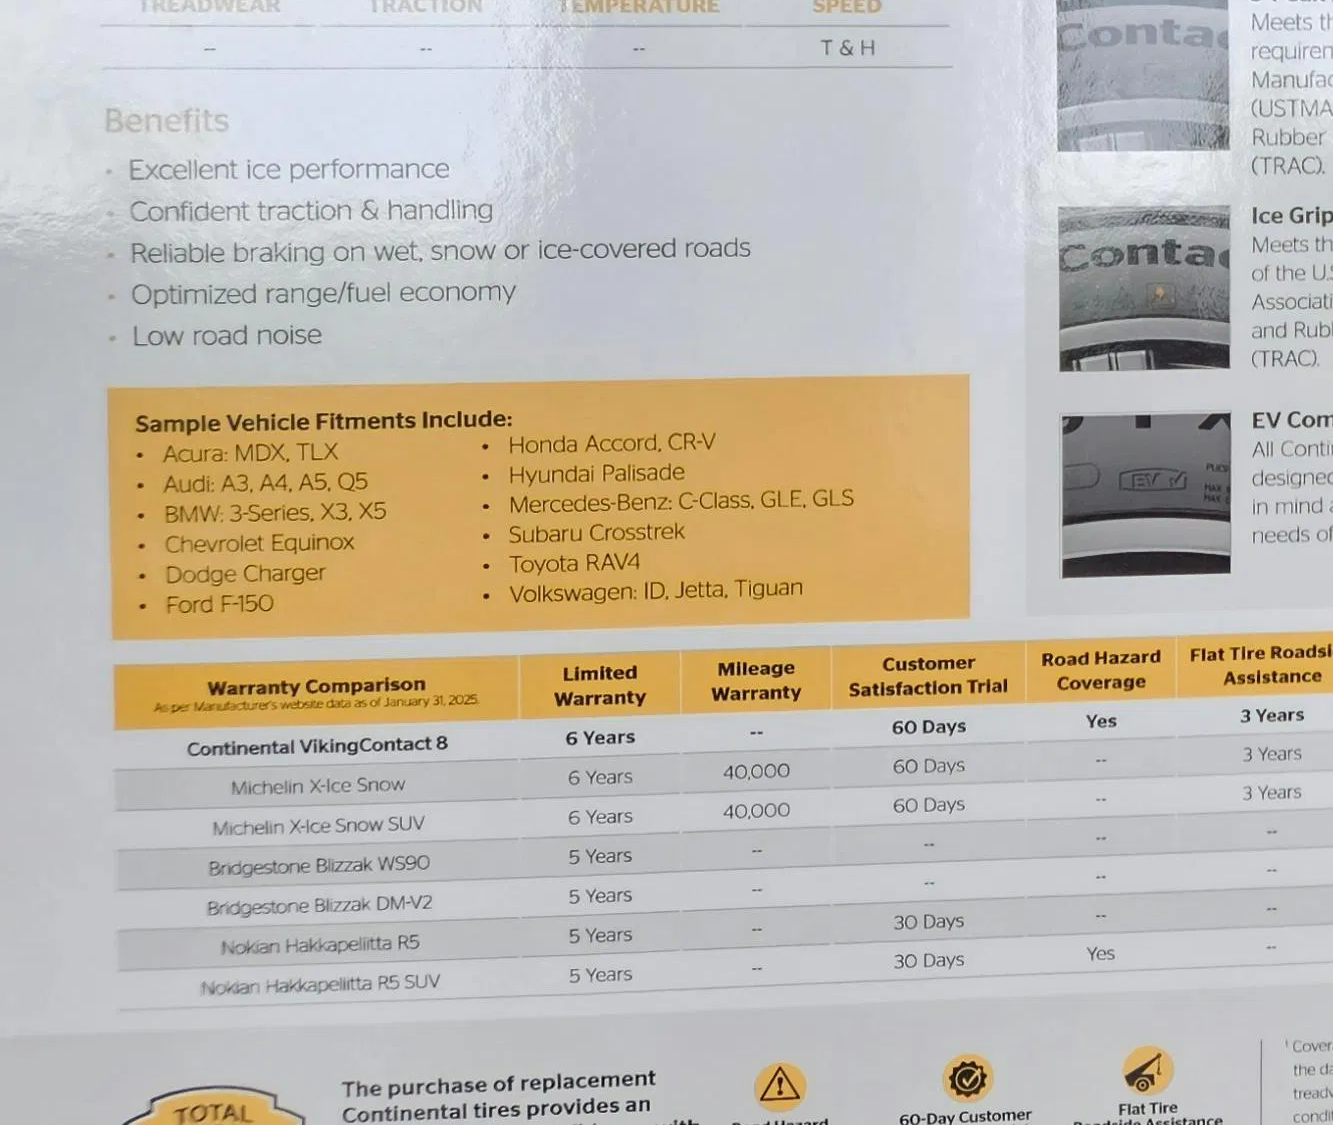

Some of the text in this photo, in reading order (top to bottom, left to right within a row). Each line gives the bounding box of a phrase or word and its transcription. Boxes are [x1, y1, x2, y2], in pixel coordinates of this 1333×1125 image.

[820, 38, 876, 57] T & H
[104, 107, 230, 136] Benefits
[129, 157, 450, 185] Excellent ice performance
[130, 197, 493, 224] Confident traction & handling
[1252, 206, 1284, 225] Ice
[131, 236, 752, 267] Reliable braking on wet, snow or ice-covered roads
[131, 280, 517, 308] Optimized range/fuel economy
[133, 323, 323, 347] Low road noise
[135, 409, 513, 437] Sample Vehicle Fitments Include:
[1252, 411, 1282, 430] EV
[509, 431, 717, 455] Honda Accord, CR-V
[509, 462, 686, 488] Hyundai Palisade
[164, 532, 356, 555] Chevrolet Equinox
[508, 521, 686, 545] Subaru Crosstrek
[508, 552, 640, 577] Toyota RAV4
[509, 578, 803, 605] Volkswagen: ID, Jetta, Tiguan
[166, 593, 275, 615] Ford F-150
[882, 656, 977, 672] Customer
[1041, 648, 1162, 667] Road Hazard
[563, 664, 638, 682] Limited
[207, 676, 426, 700] Warranty Comparison
[848, 677, 1008, 698] Satisfaction Trial
[1056, 676, 1147, 693] Coverage
[553, 690, 647, 708] Warranty
[565, 729, 636, 746] 6 Years
[892, 719, 967, 737] 60 Days
[186, 734, 449, 757] Continental VikingContact 8
[722, 762, 791, 781] 40,000
[231, 776, 406, 796] Michelin X-Ice Snow
[208, 854, 431, 879] Bridgestone Blizzak WS90
[1293, 1063, 1317, 1078] the
[341, 1069, 657, 1100] The purchase of replacement
[172, 1103, 254, 1124] TOTAL
[899, 1109, 1033, 1125] 60-Day Customer
[1118, 1101, 1179, 1116] Flat Tire
